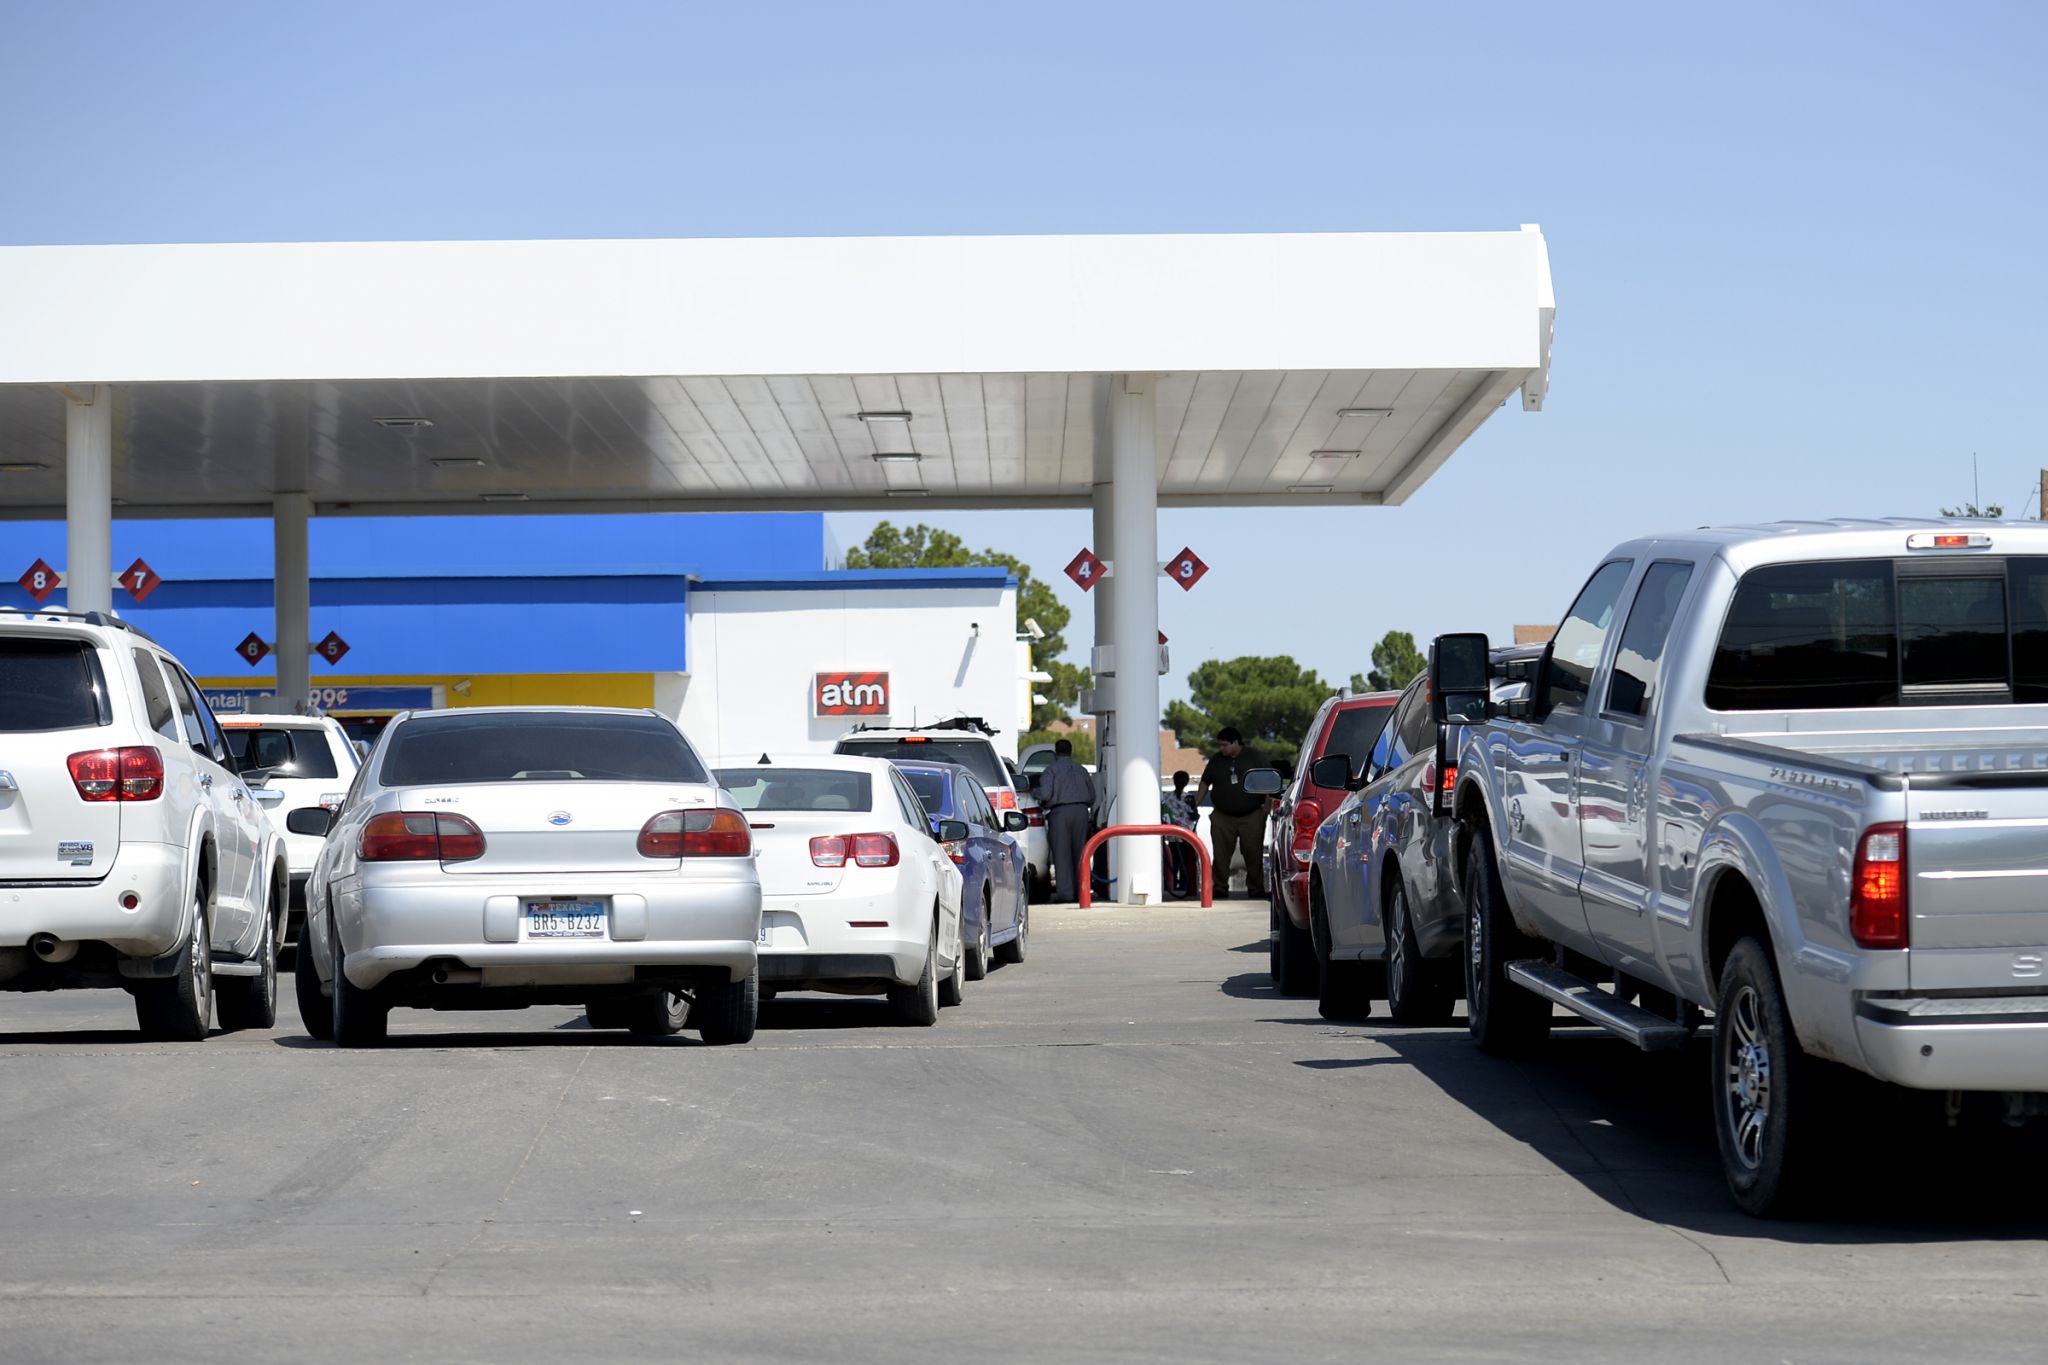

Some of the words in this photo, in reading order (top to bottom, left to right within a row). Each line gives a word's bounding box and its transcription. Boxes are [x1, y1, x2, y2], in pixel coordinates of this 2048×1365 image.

[1078, 560, 1092, 579] 4
[1180, 560, 1194, 579] 3
[33, 571, 46, 589] 8
[133, 571, 146, 589] 7
[247, 642, 258, 656] 6
[327, 642, 338, 656] 5
[821, 679, 885, 706] atm
[548, 903, 582, 911] TEXAS
